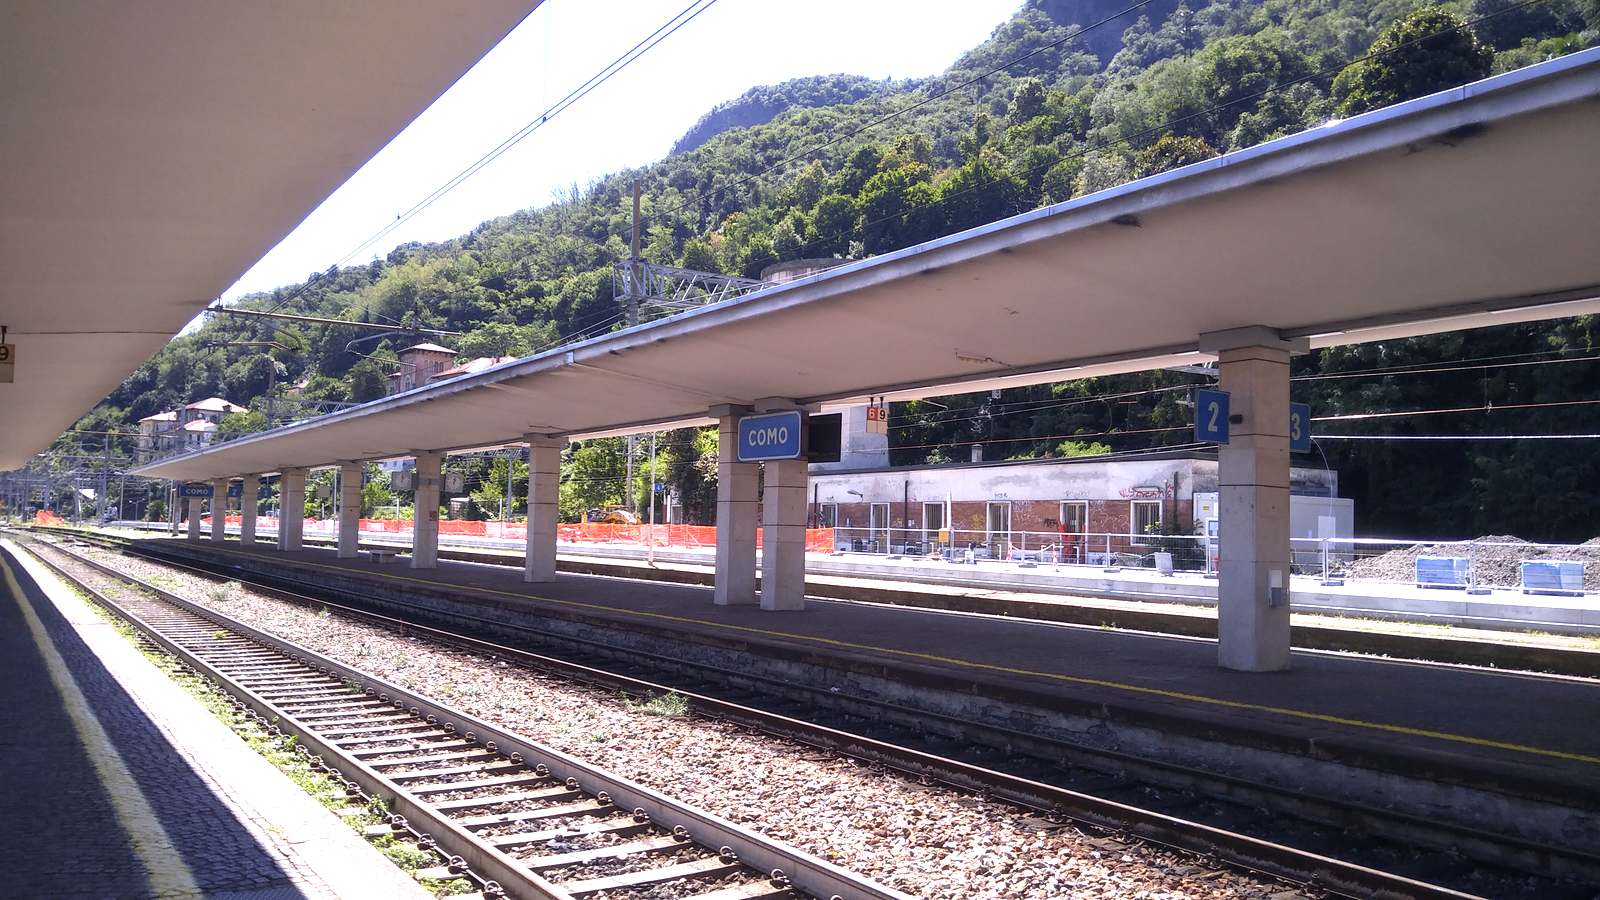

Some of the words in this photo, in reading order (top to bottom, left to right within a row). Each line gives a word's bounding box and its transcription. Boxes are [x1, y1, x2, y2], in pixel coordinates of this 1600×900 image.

[868, 409, 876, 418] 6
[879, 409, 886, 420] 9
[1207, 401, 1219, 432] 2
[748, 426, 788, 446] COMO
[1291, 412, 1301, 440] 3
[231, 488, 238, 496] 2
